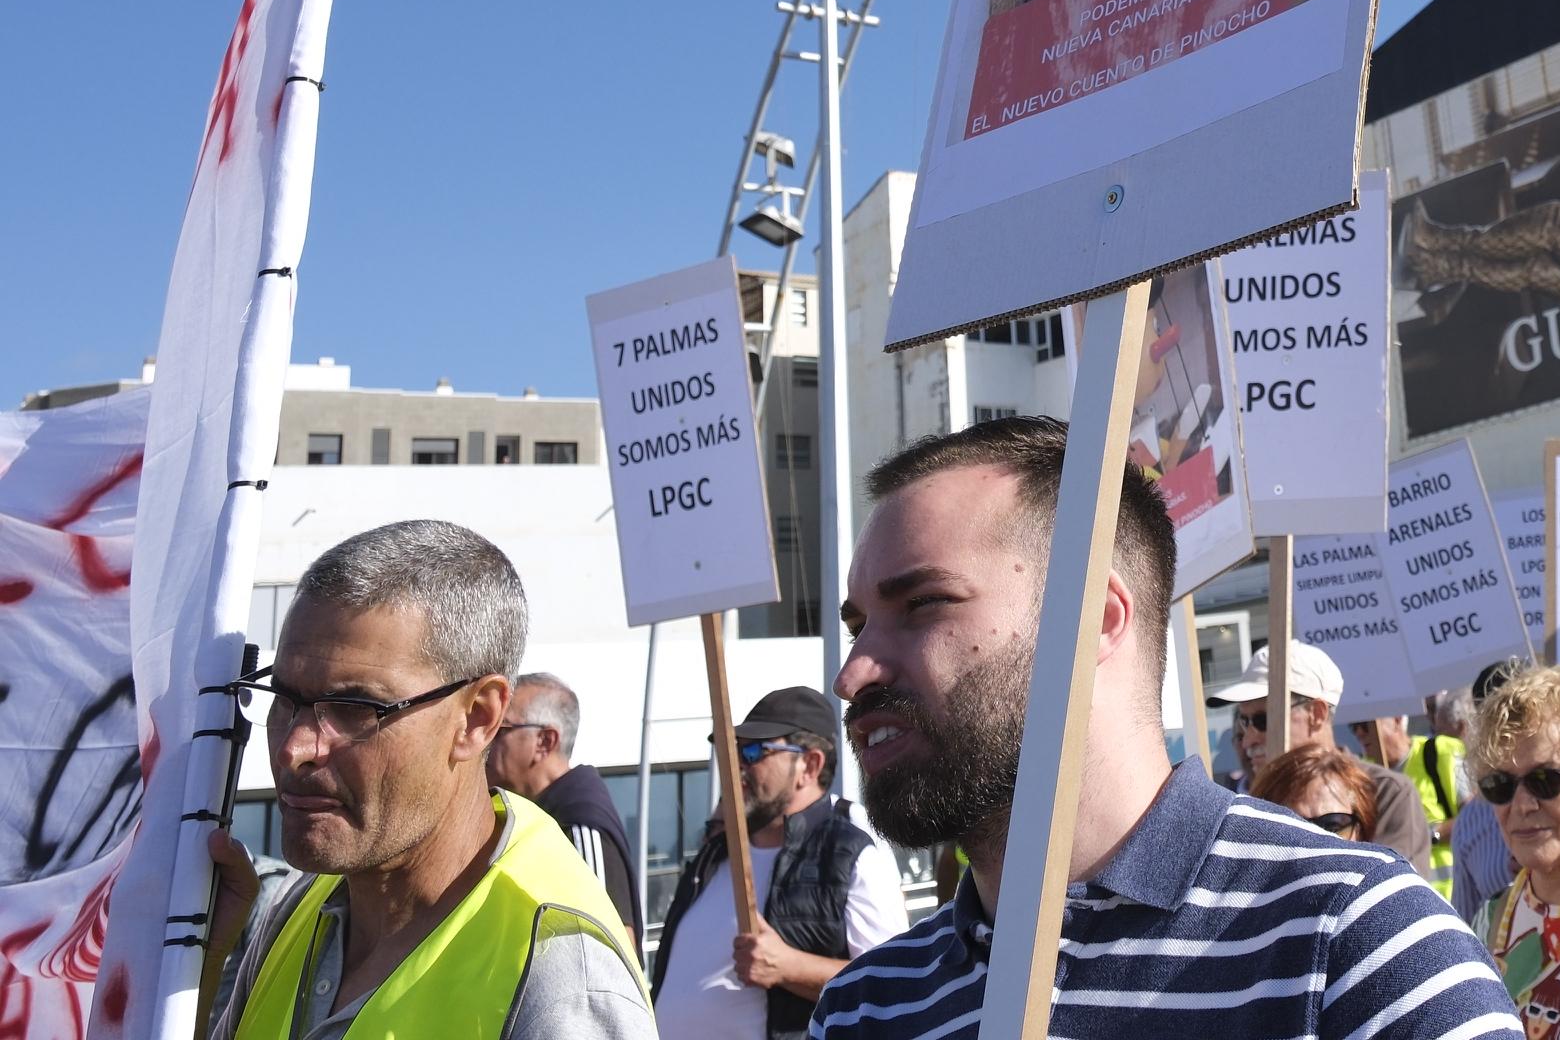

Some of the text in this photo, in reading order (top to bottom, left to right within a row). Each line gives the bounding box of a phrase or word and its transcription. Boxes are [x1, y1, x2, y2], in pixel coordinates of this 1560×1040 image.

[1041, 28, 1103, 64] NUEVA
[971, 0, 1271, 134] EL NUEVO CUENTO DE PINOCHO
[1225, 271, 1341, 304] UNIDOS
[613, 318, 719, 367] 7 PALMAS
[1233, 316, 1368, 354] MOS MÁS
[631, 372, 715, 415] UNIDOS
[1239, 379, 1316, 413] PGC
[618, 414, 740, 466] SOMOS MÁS
[648, 477, 713, 518] LPGC
[1388, 473, 1452, 509] BARRIO
[1388, 503, 1473, 546] ARENALES
[1521, 508, 1546, 524] LOS
[1293, 544, 1376, 569] LAS PALMA
[1406, 540, 1474, 576] UNIDOS
[1507, 534, 1546, 550] BARRI
[1296, 574, 1346, 592] SIEMPRE
[1521, 559, 1546, 574] LPG
[1313, 591, 1379, 615] UNIDOS
[1401, 569, 1499, 613] SOMOS MÁS
[1304, 616, 1399, 645] SOMOS MÁS
[1429, 613, 1482, 645] LPGC
